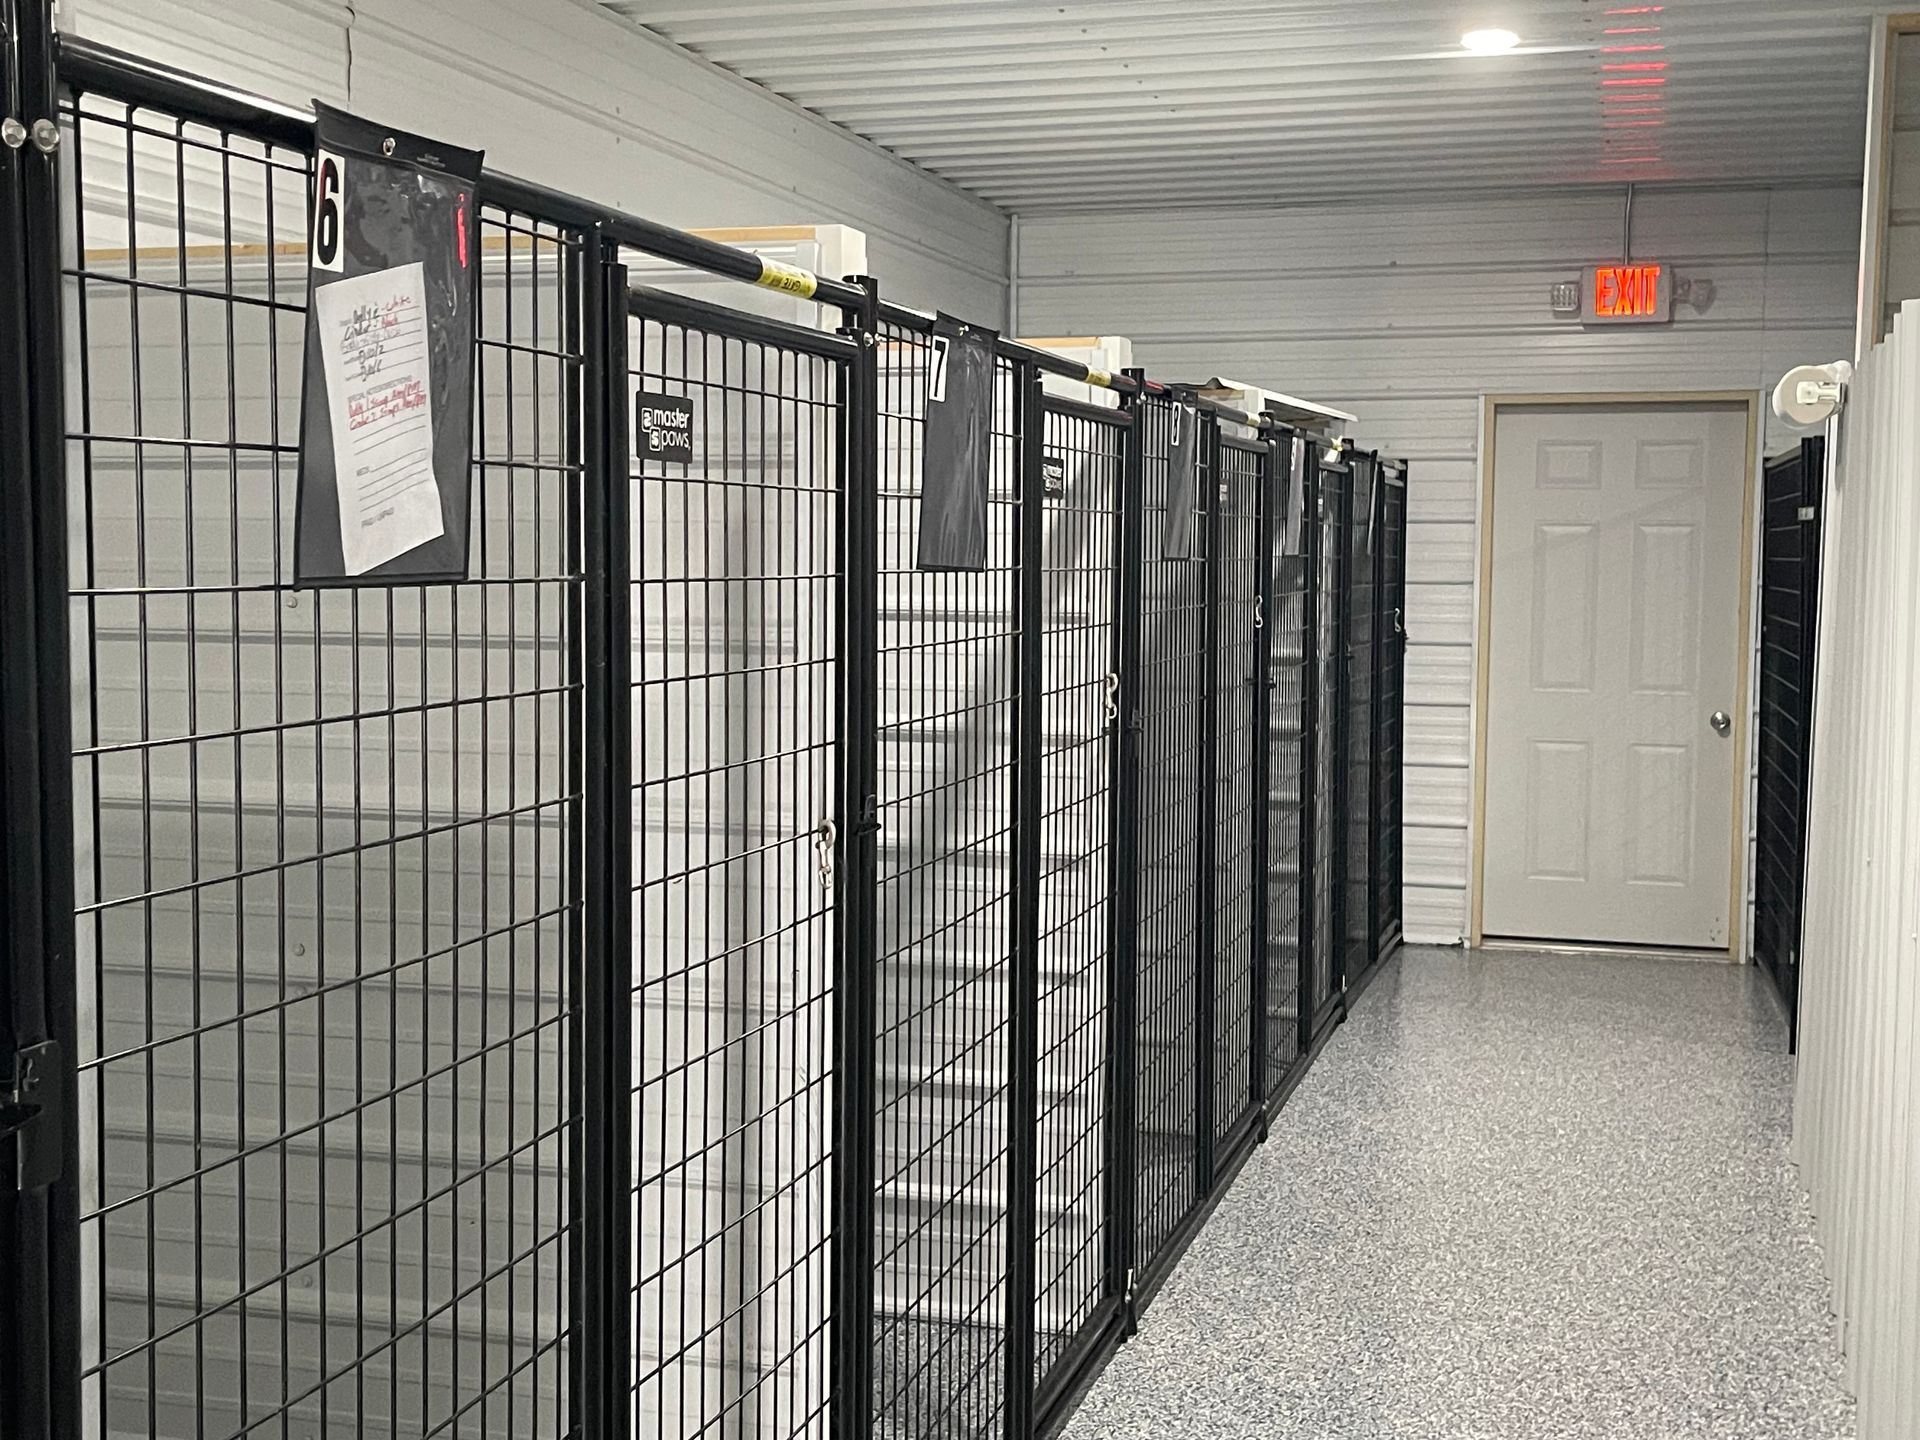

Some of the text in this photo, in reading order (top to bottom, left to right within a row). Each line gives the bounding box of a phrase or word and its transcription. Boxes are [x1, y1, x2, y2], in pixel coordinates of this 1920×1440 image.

[317, 157, 339, 265] 6
[1595, 266, 1661, 316] EXIT
[934, 339, 947, 397] 7
[653, 407, 690, 429] master
[661, 430, 689, 452] paws
